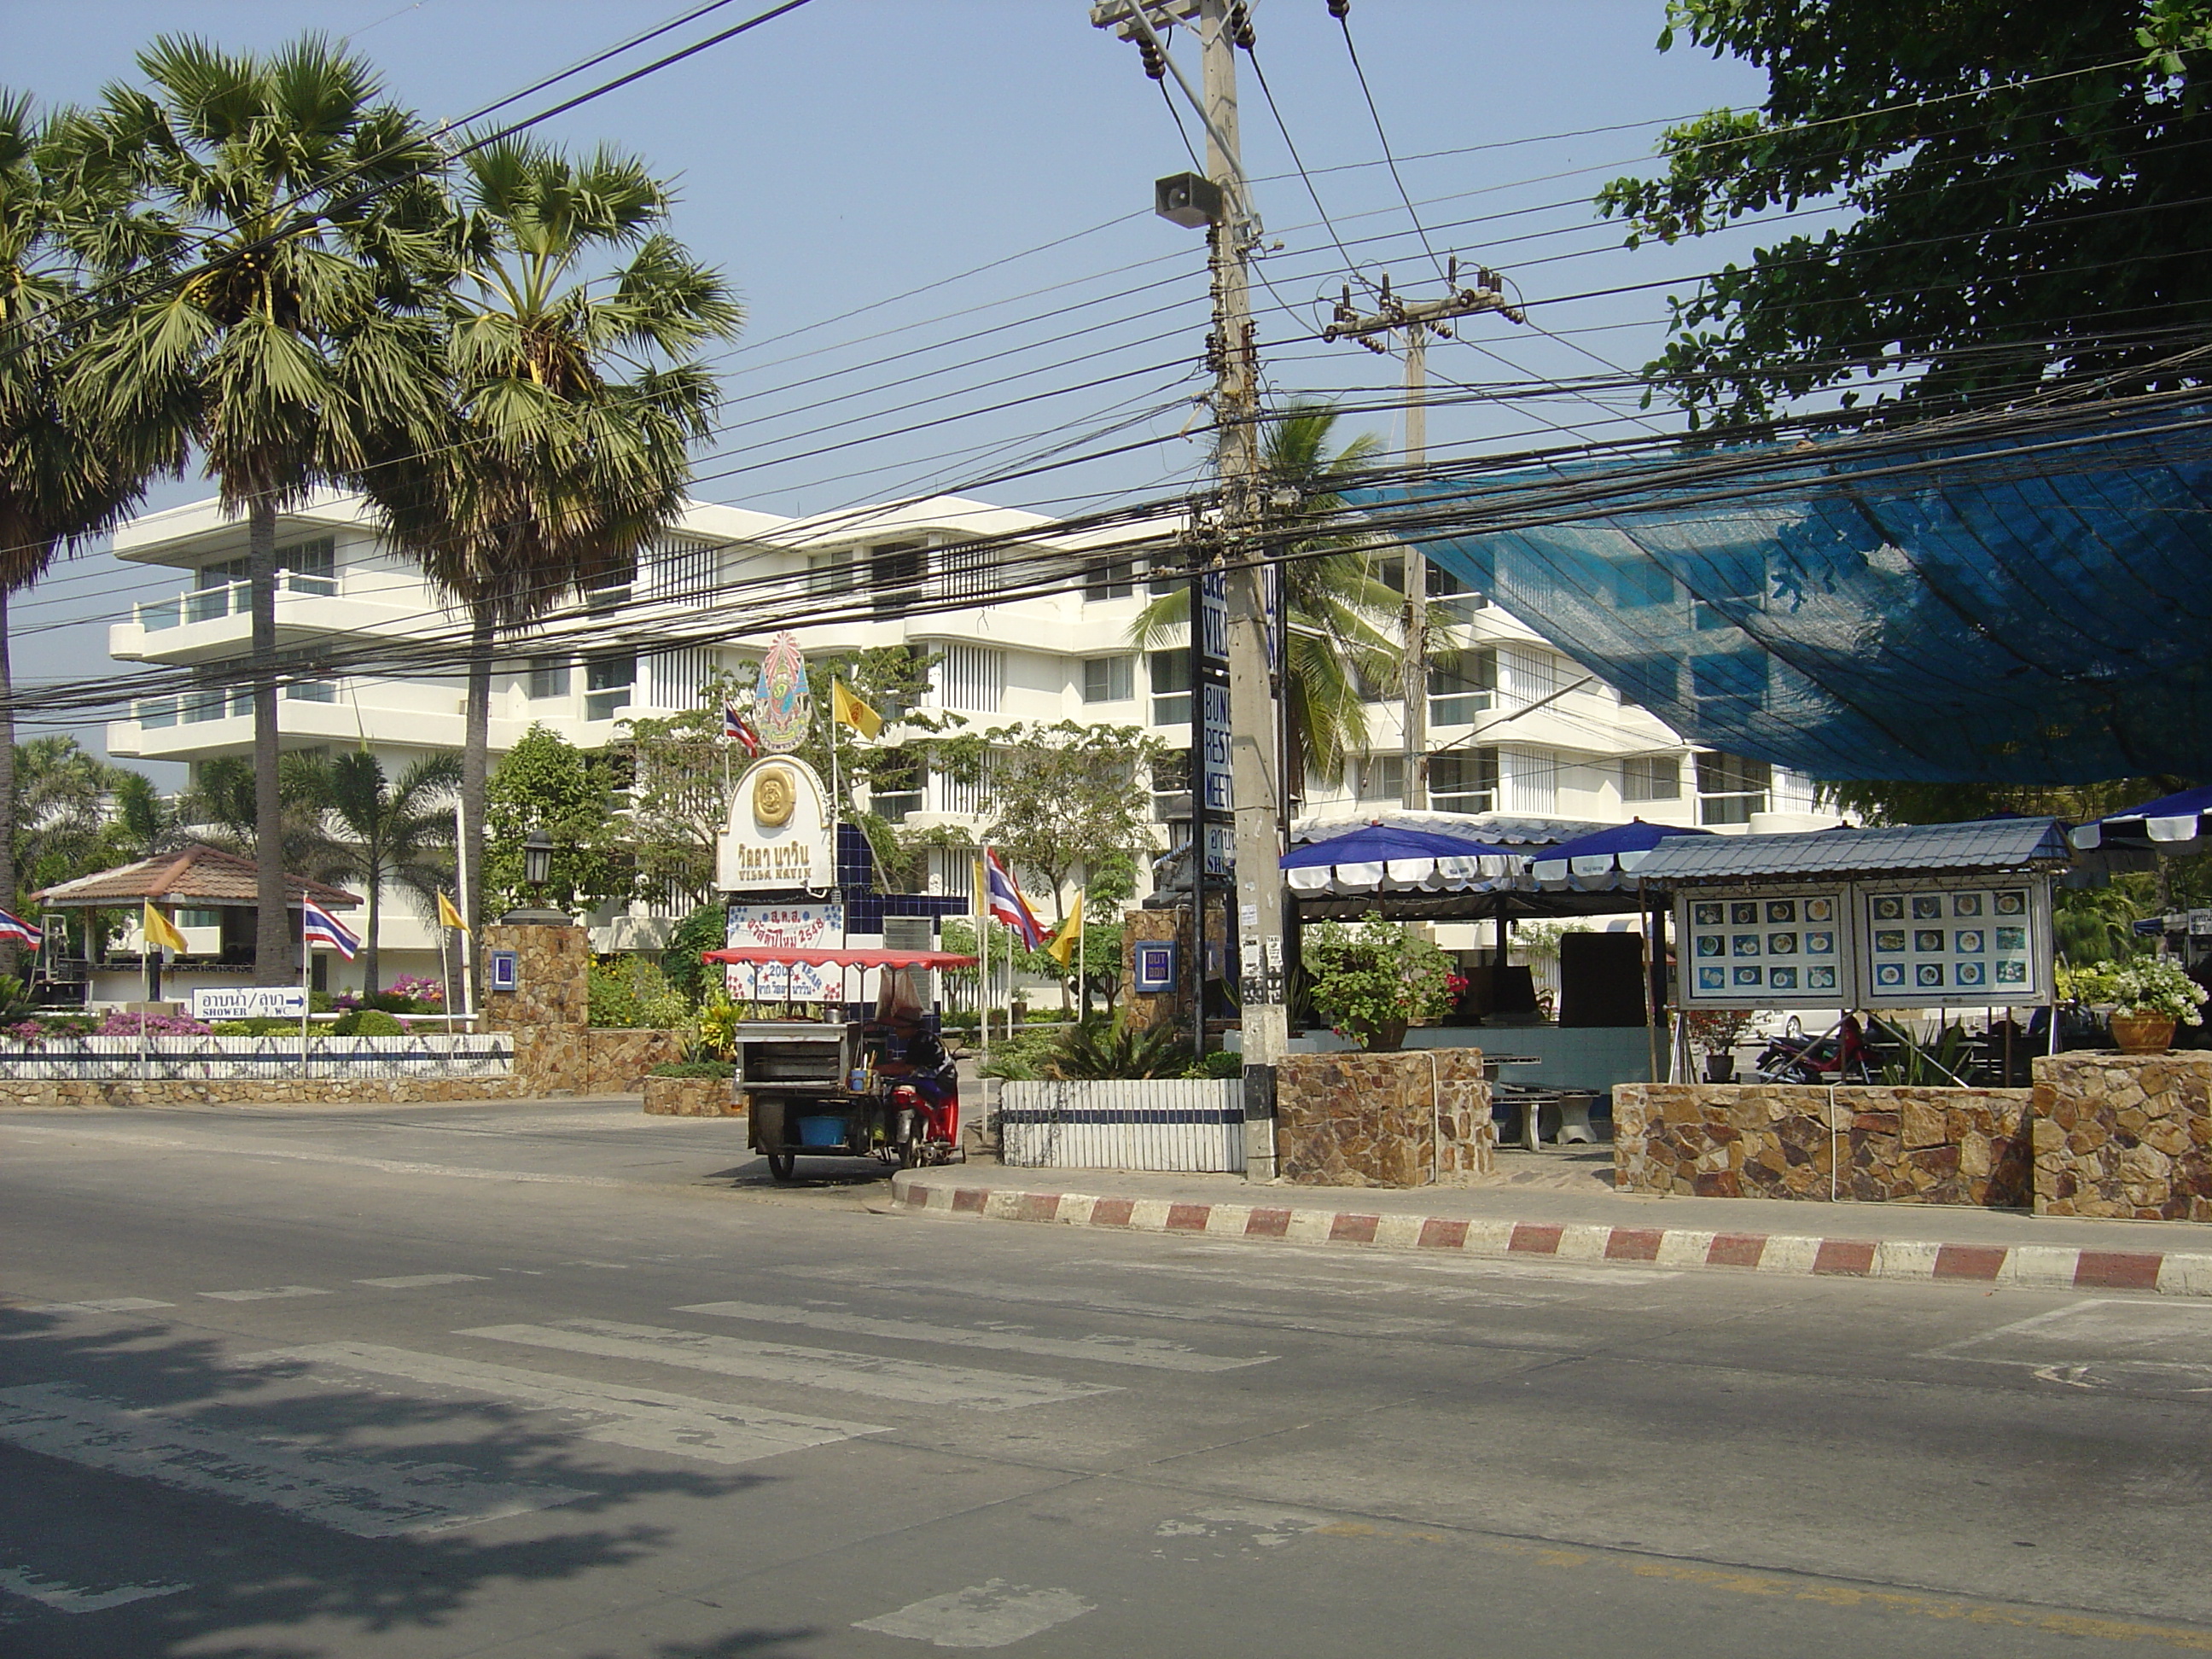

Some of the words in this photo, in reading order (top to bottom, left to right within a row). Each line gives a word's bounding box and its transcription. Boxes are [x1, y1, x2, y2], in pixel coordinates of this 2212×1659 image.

[774, 841, 810, 865] นาวิน
[738, 870, 771, 881] VILLA
[775, 867, 812, 879] NAVIN
[798, 917, 824, 943] 2548
[1148, 953, 1166, 964] OUT
[202, 1008, 247, 1017] SHOWER
